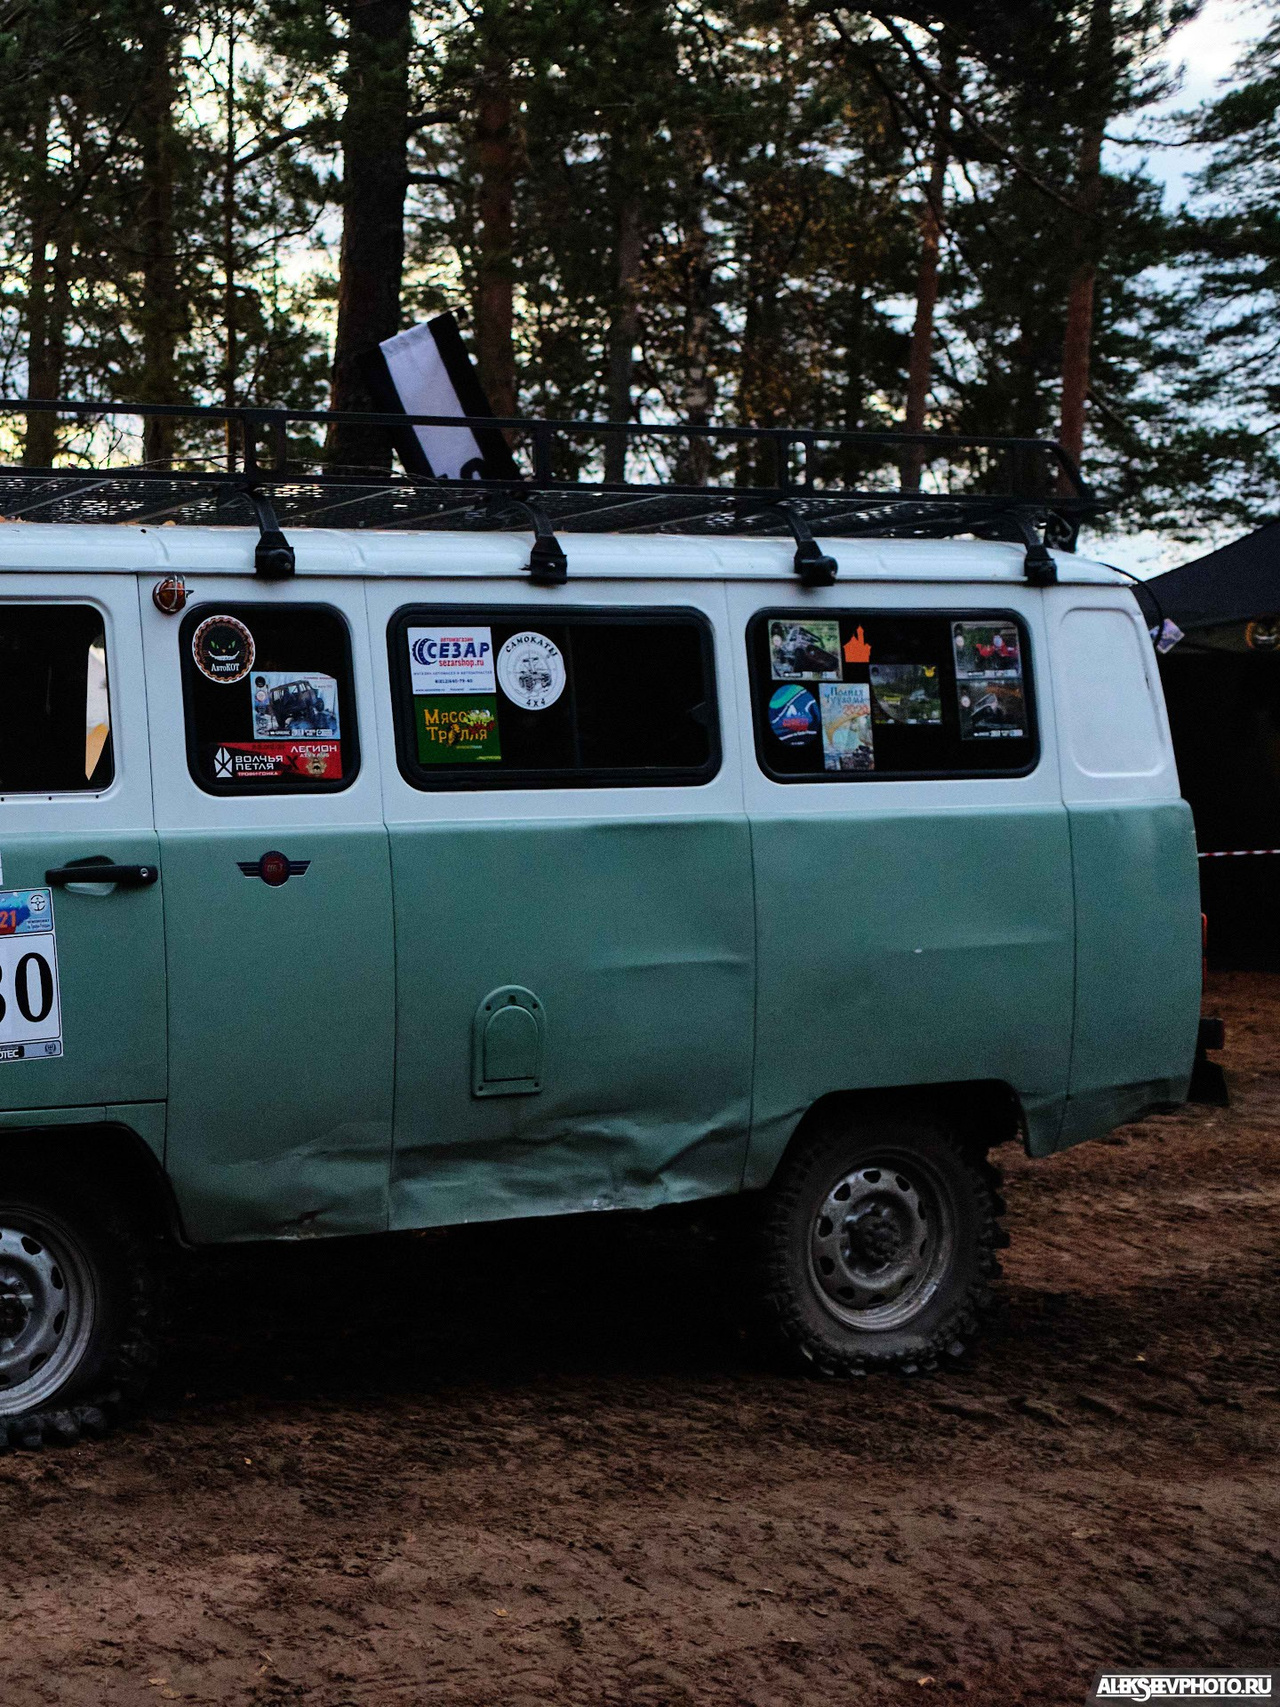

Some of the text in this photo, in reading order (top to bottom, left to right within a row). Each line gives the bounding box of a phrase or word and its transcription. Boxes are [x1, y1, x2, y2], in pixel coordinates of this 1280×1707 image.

[426, 642, 490, 659] СЕЗАР
[505, 636, 558, 657] САМОКАТЫ
[438, 659, 485, 668] sezarshop.ru
[424, 709, 467, 726] Мясо
[290, 745, 338, 753] ЛЕГИОН
[235, 755, 284, 763] ВОЛЧЬЯ
[235, 763, 274, 771] ПЕТЛЯ
